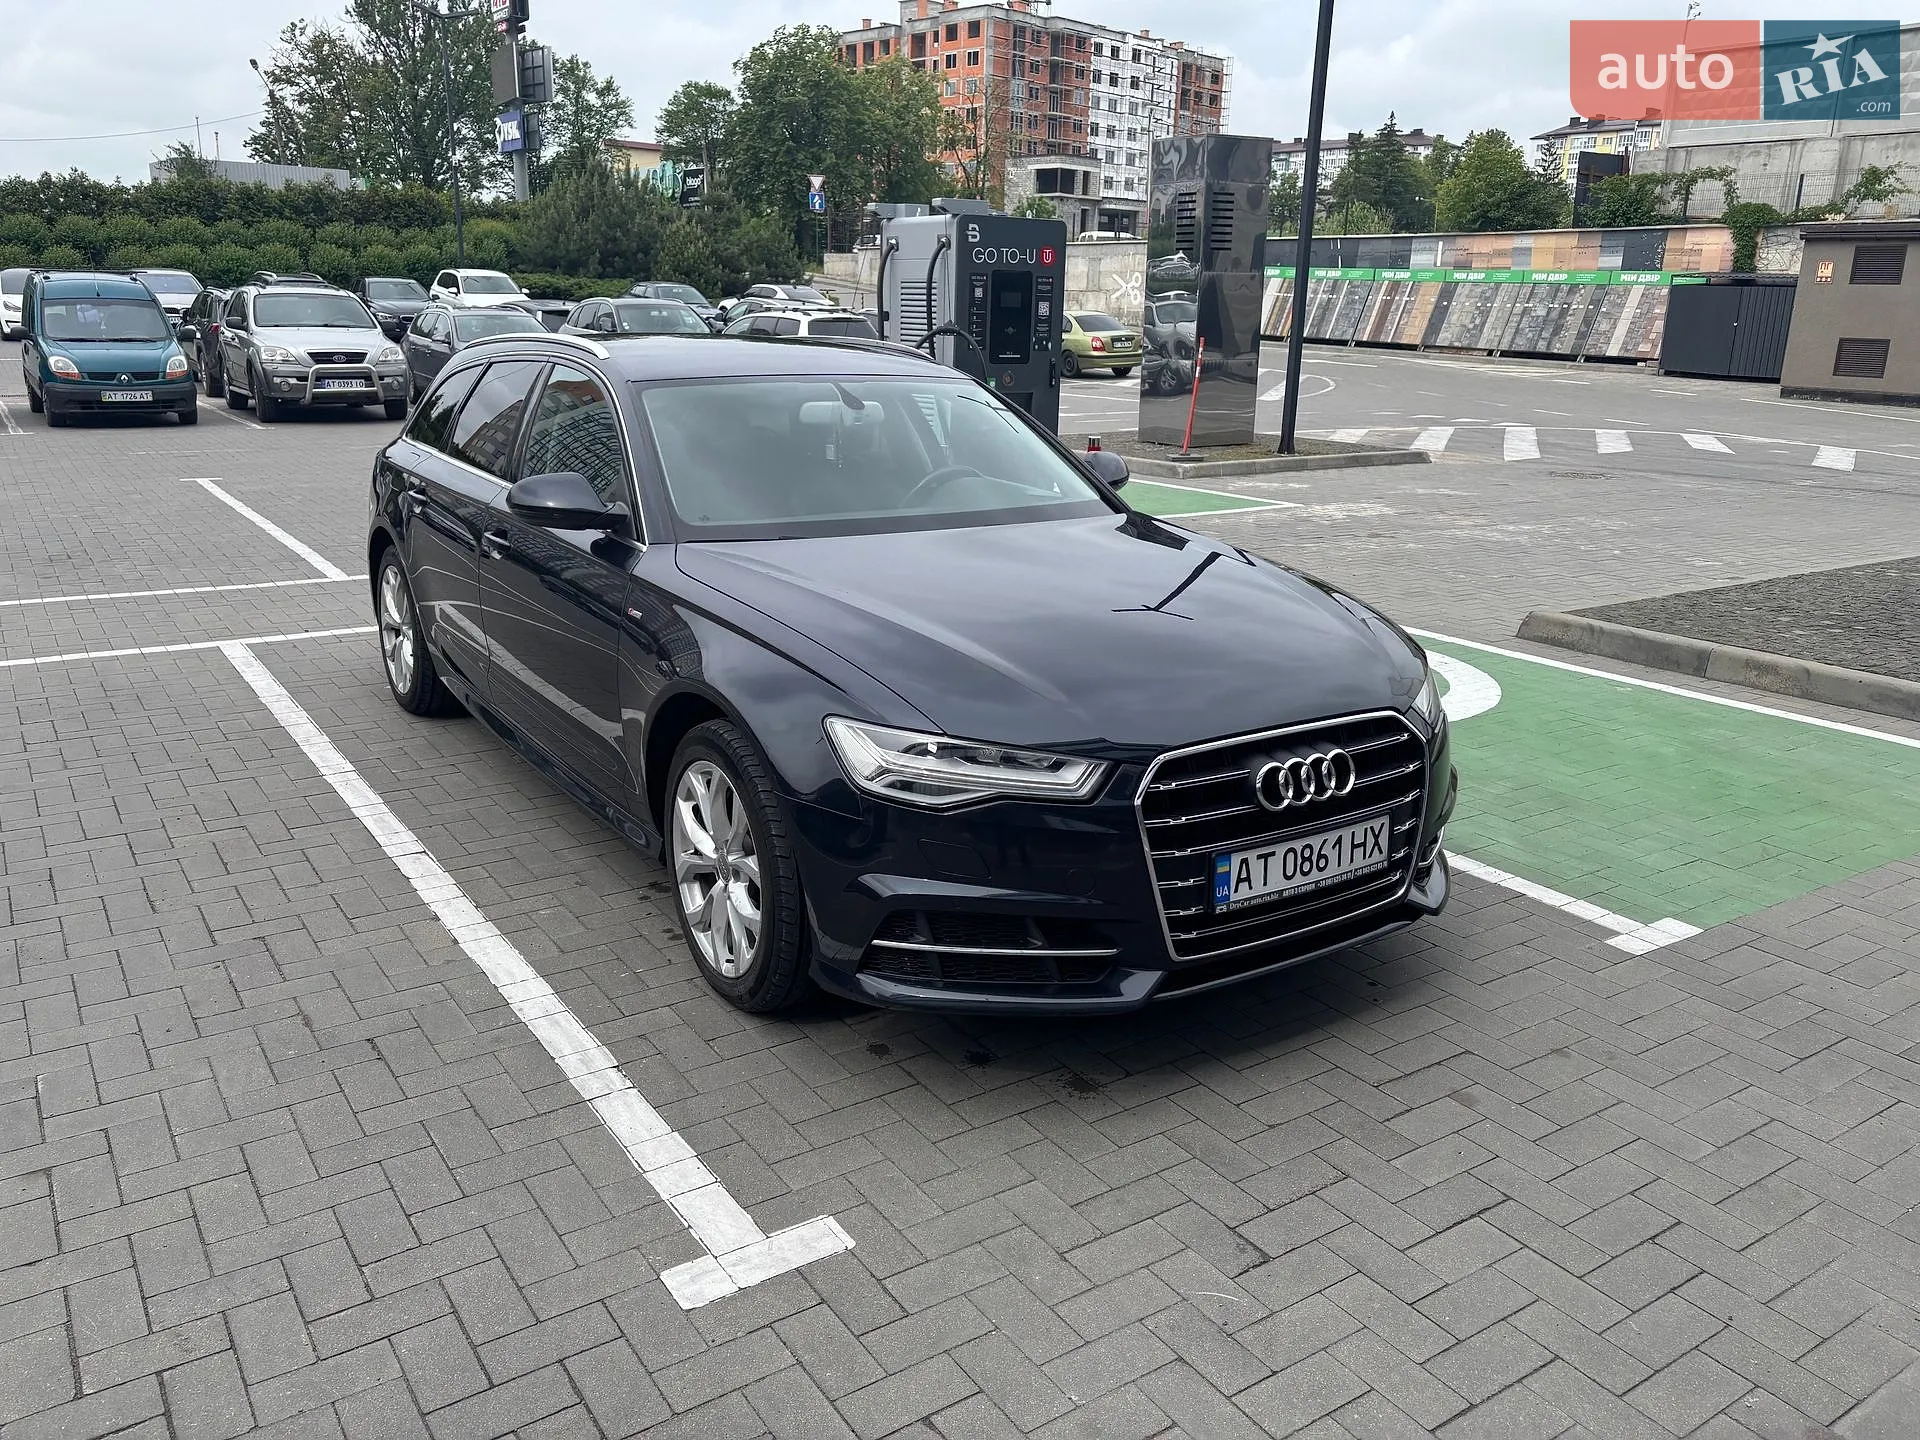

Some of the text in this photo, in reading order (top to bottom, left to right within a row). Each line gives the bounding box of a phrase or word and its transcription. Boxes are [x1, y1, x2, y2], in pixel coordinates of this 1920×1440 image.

[973, 247, 998, 263] GO
[1000, 248, 1036, 264] TO-U
[108, 392, 118, 400] AT
[140, 392, 150, 400] AT
[1233, 822, 1385, 893] AT 0861 HX
[1216, 885, 1229, 897] UA
